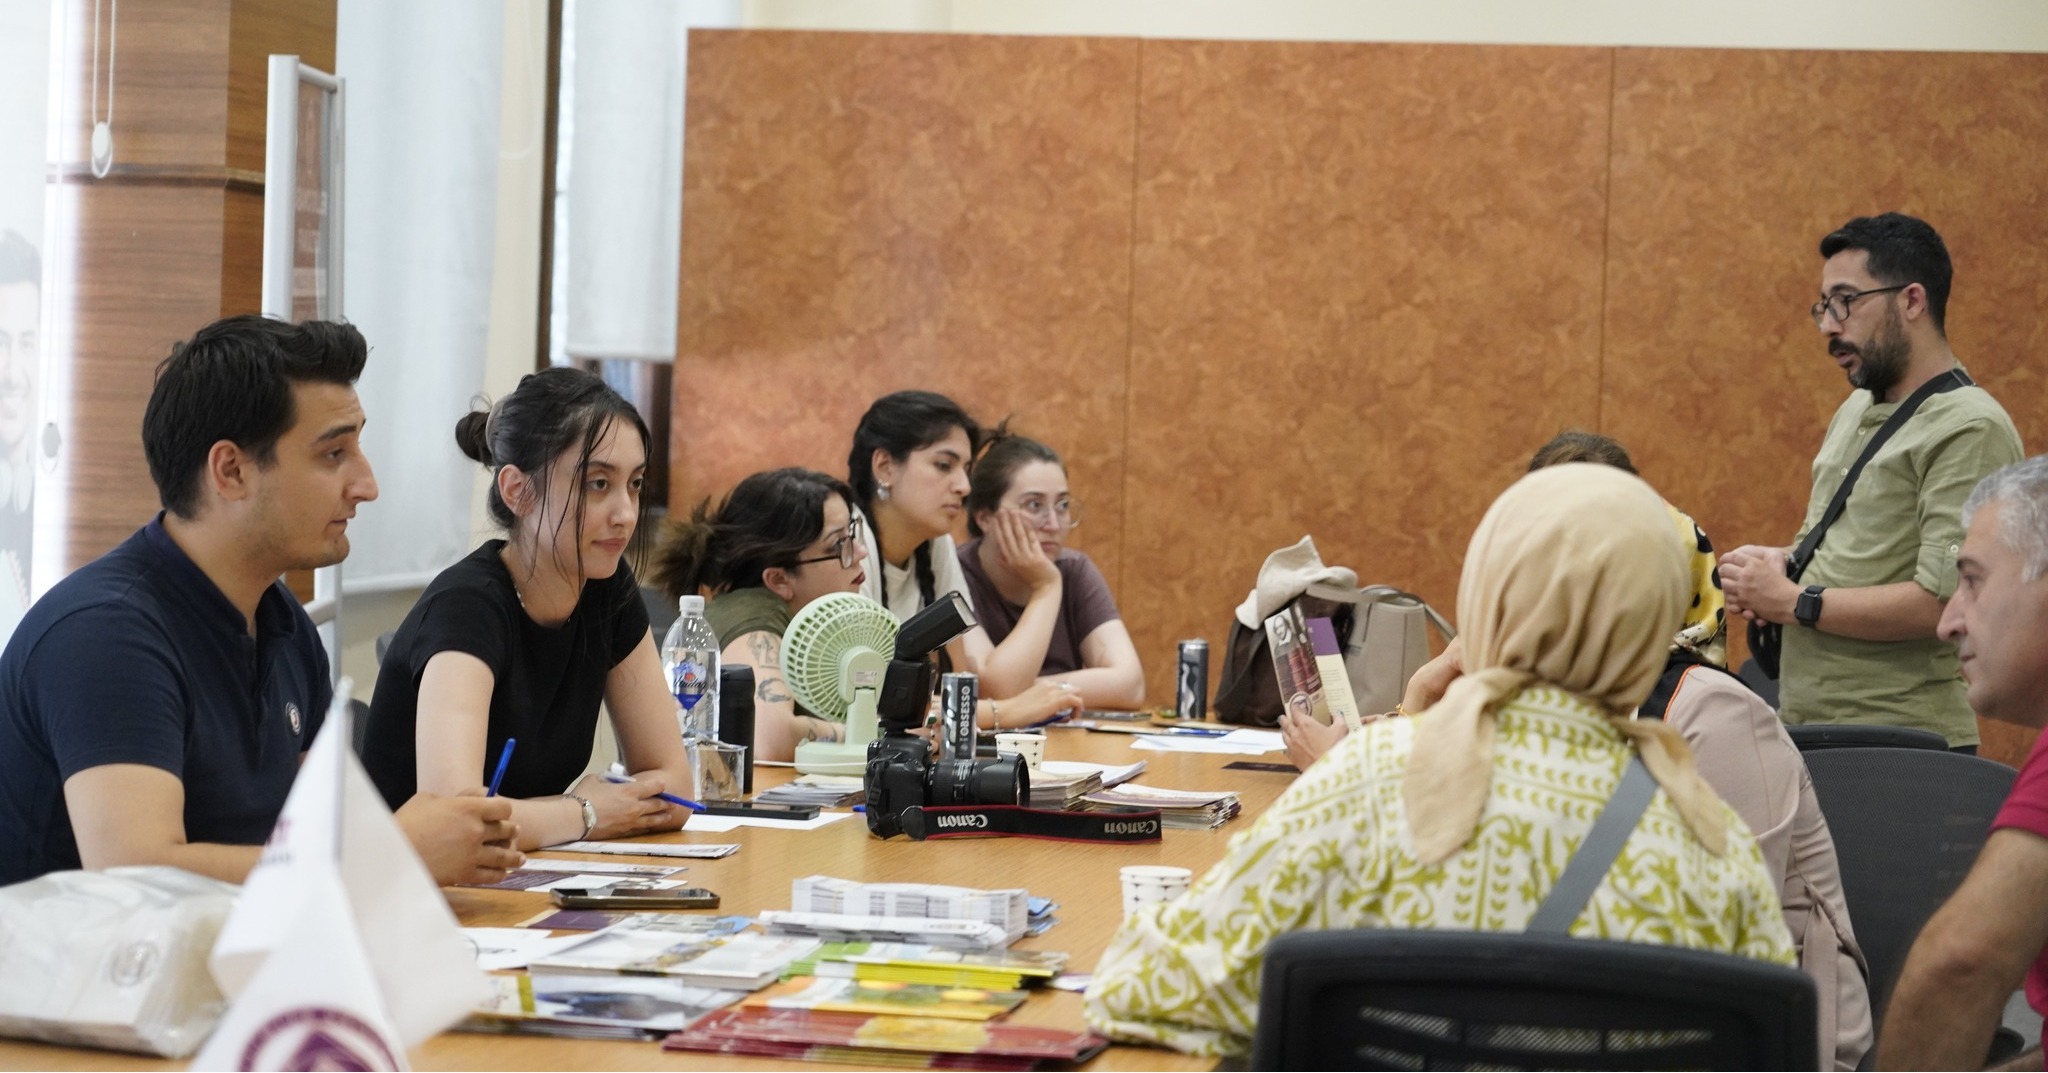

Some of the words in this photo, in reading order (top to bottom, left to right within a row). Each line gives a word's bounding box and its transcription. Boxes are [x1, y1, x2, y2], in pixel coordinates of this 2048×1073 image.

[959, 685, 971, 737] OBSESSO
[937, 814, 989, 829] Canon
[1104, 820, 1158, 835] Canon
